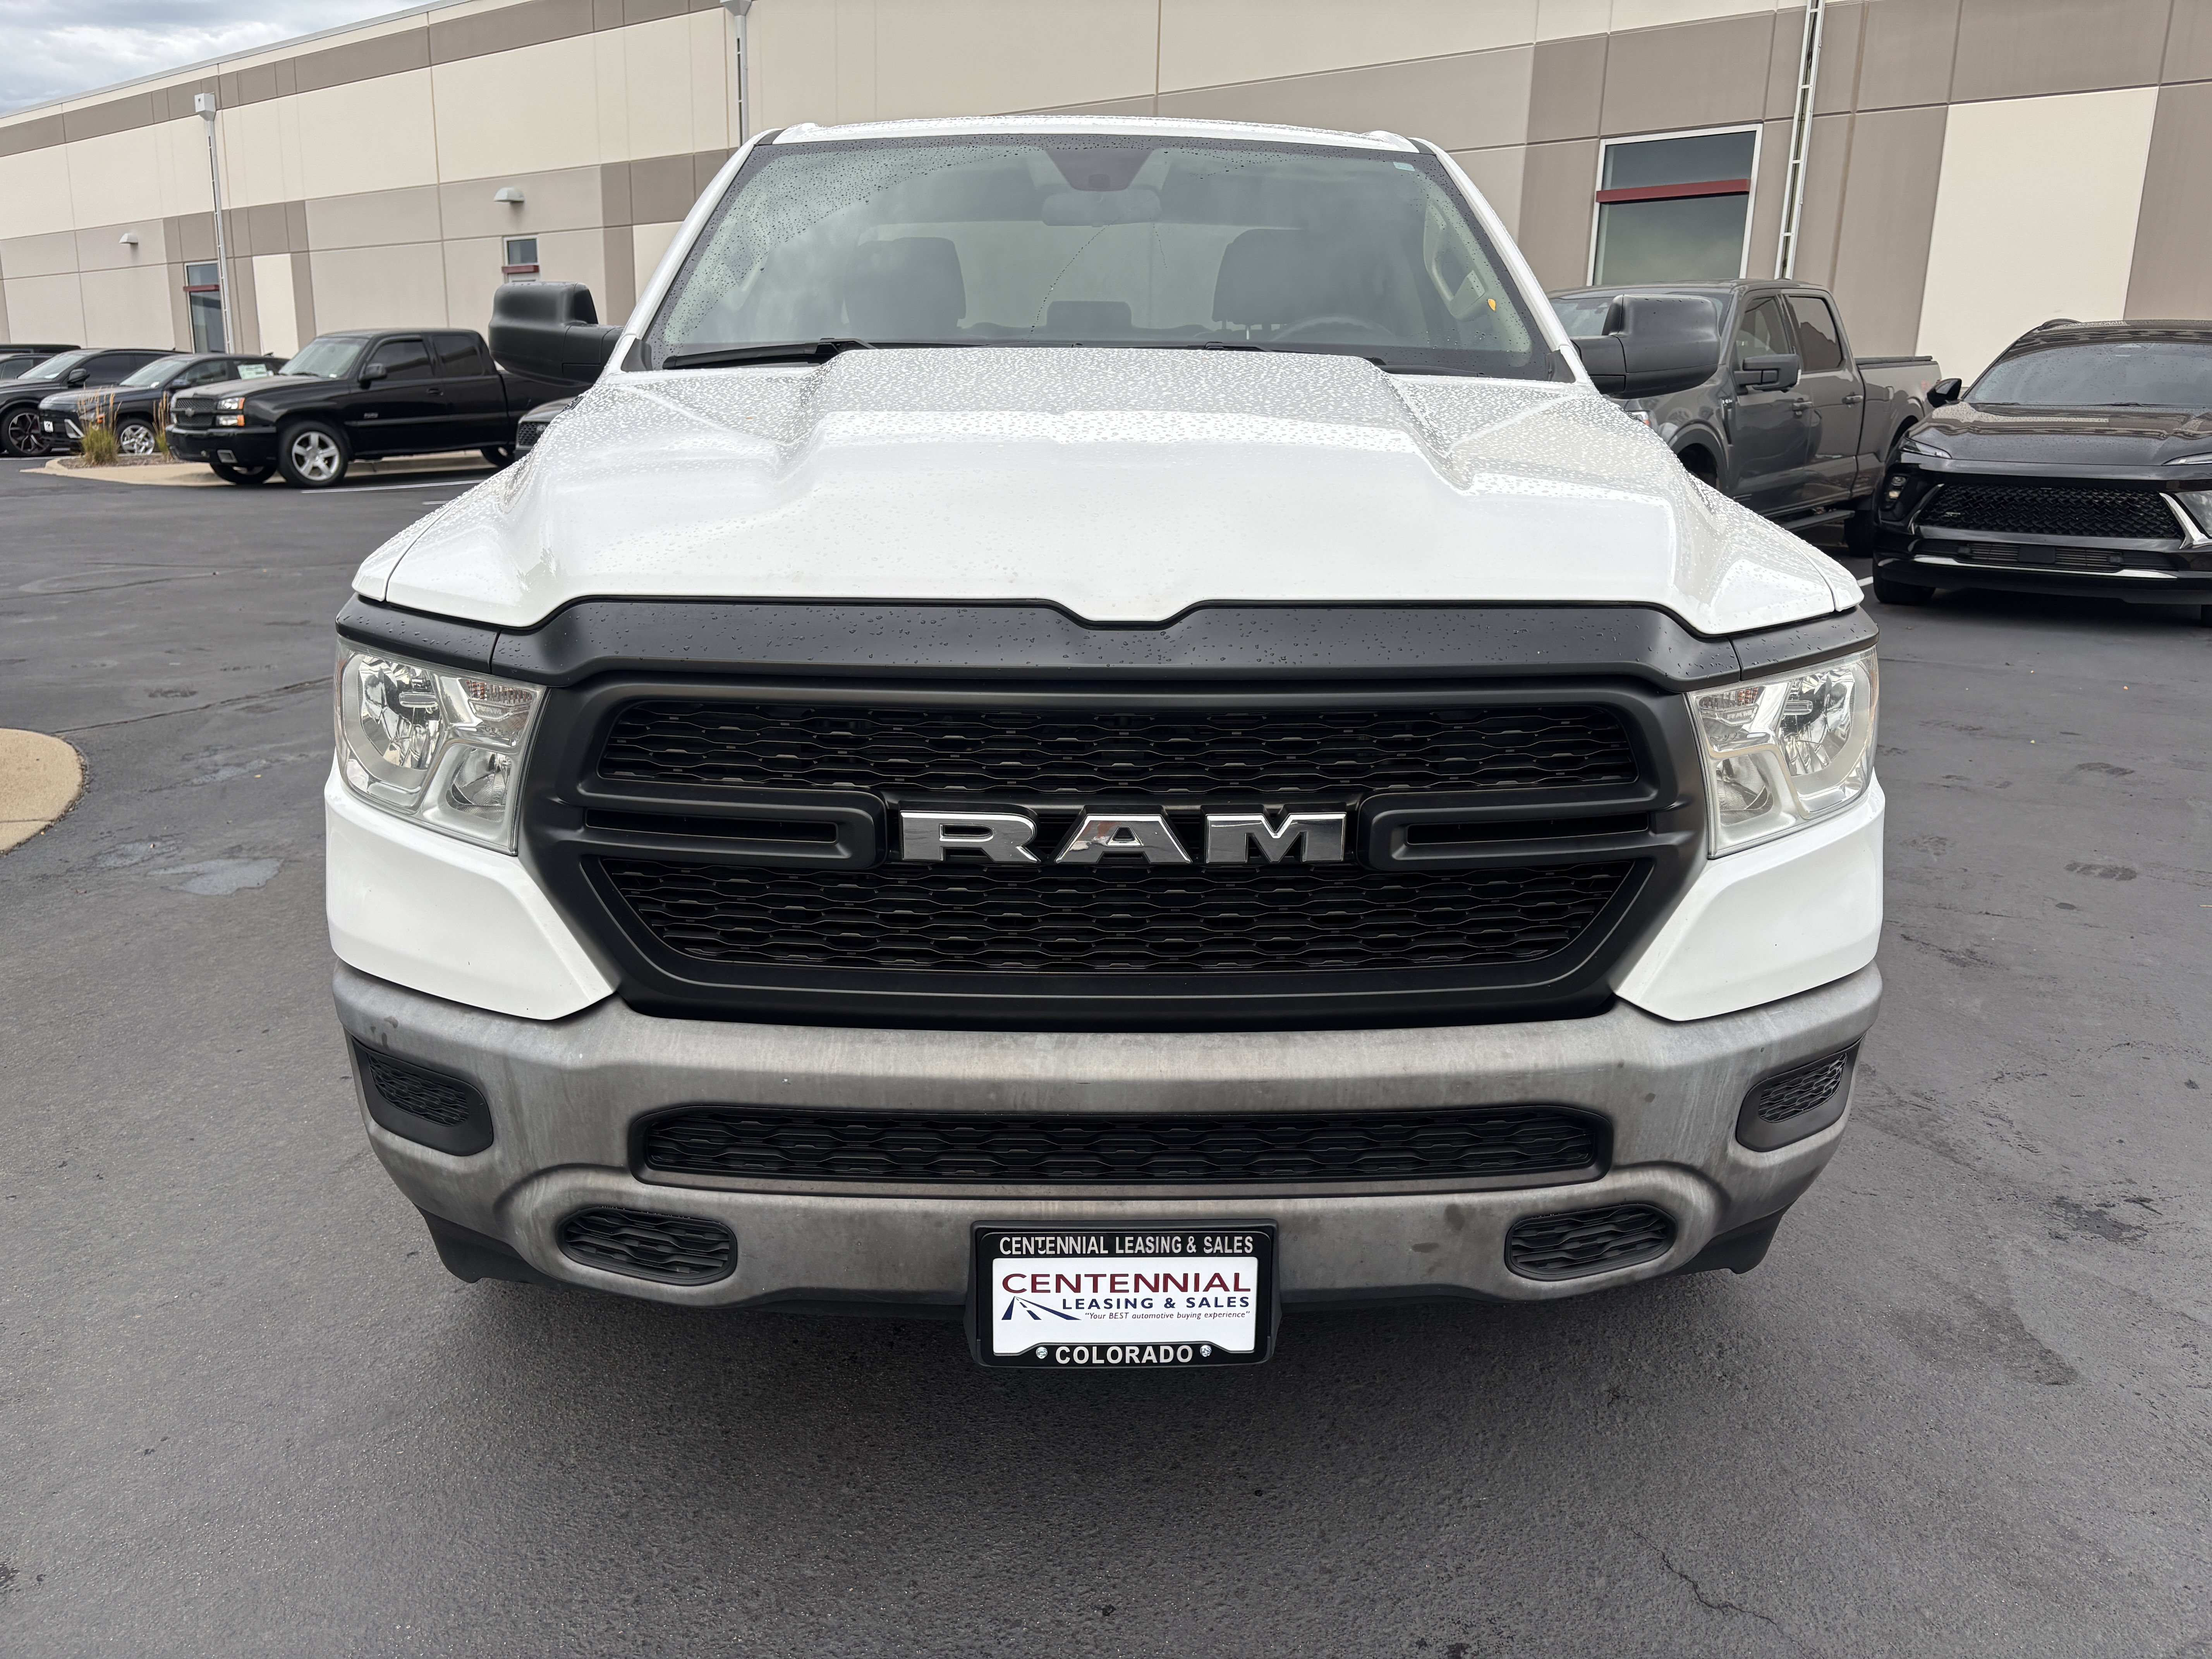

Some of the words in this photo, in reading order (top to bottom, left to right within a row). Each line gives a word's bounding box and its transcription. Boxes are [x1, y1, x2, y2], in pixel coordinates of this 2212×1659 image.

[900, 812, 1347, 864] RAM
[1000, 1236, 1108, 1255] CENTENNIAL
[1116, 1236, 1182, 1254] LEASING
[1186, 1236, 1197, 1253] &
[1204, 1236, 1253, 1254] SALES
[1002, 1273, 1251, 1293] CENTENNIAL
[1063, 1298, 1153, 1310] LEASING
[1164, 1297, 1176, 1309] &
[1186, 1297, 1249, 1308] SALES
[1176, 1312, 1201, 1320] buying
[1055, 1345, 1193, 1364] COLORADO
